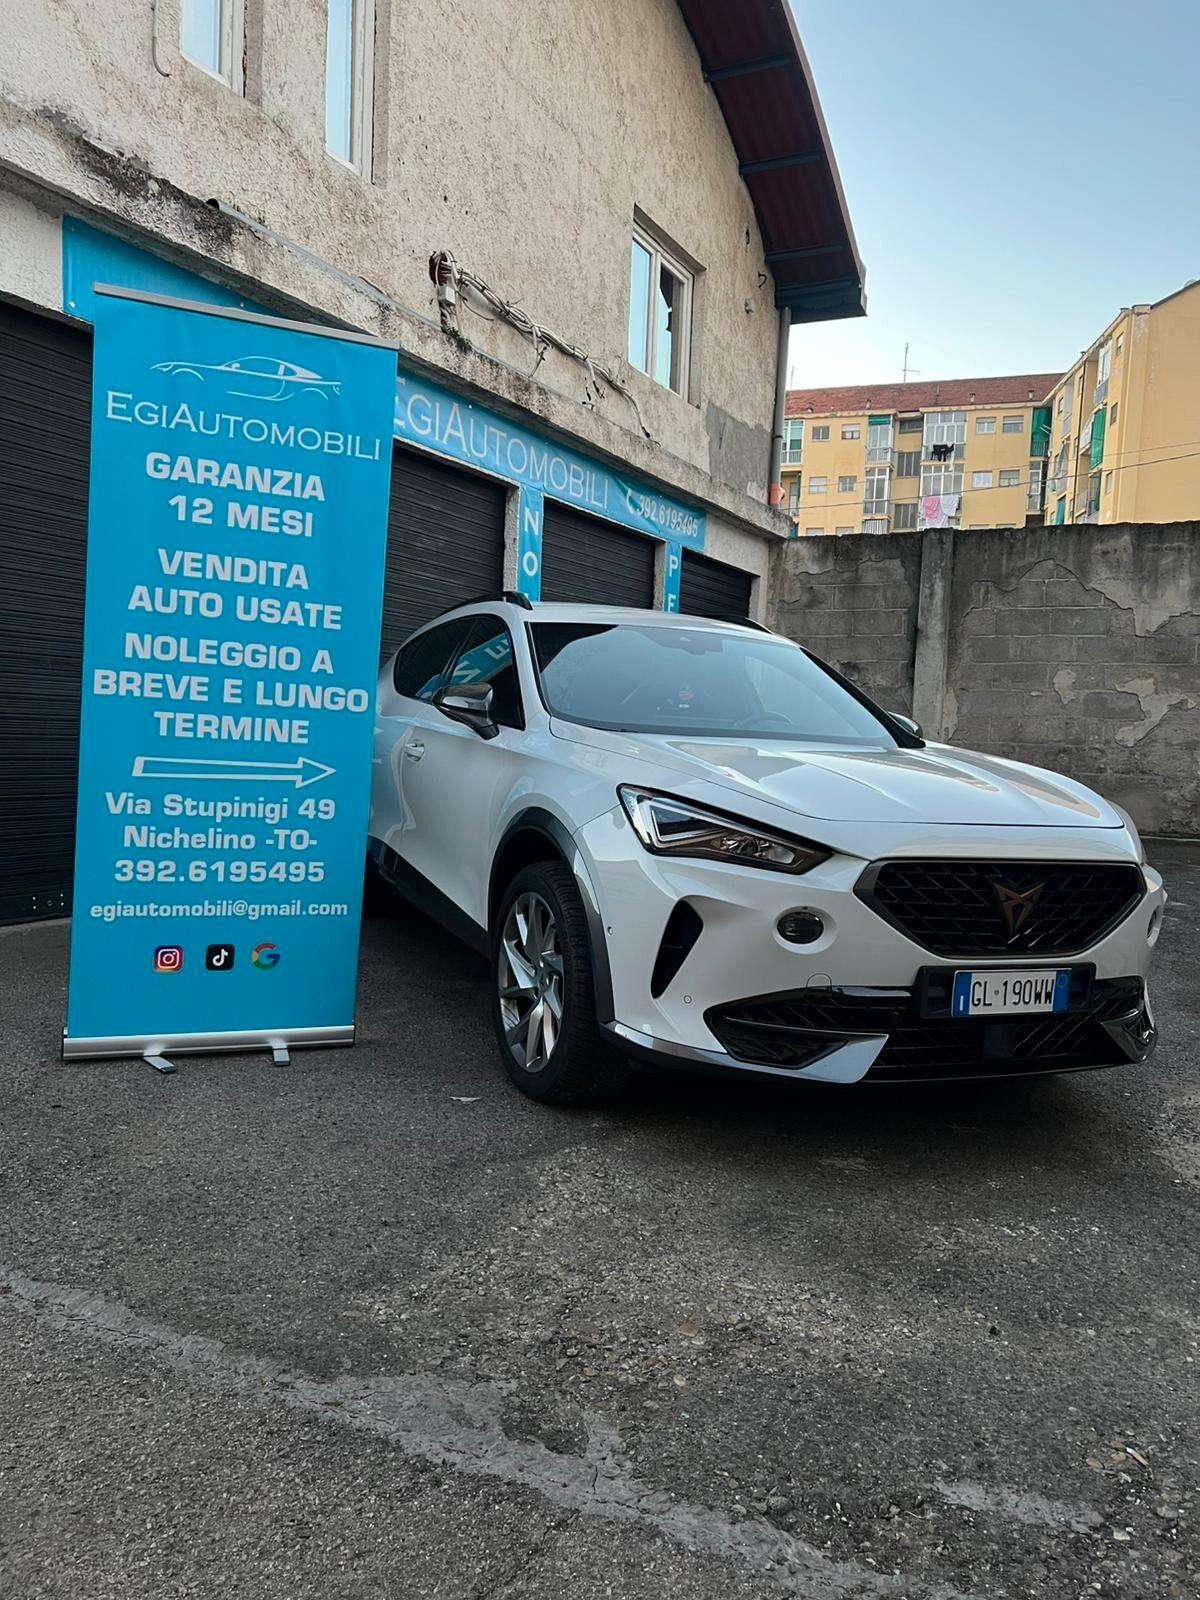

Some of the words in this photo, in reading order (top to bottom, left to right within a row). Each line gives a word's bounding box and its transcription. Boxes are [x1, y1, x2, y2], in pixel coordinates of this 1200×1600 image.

[106, 390, 381, 461] EGIAUTOMOBILI
[145, 452, 326, 501] GARANZIA
[168, 495, 214, 526] 12
[226, 502, 314, 538] MESI
[157, 548, 310, 590] VENDITA
[127, 585, 224, 619] AUTO
[235, 595, 342, 631] USATE
[124, 632, 301, 672] NOLEGGIO
[310, 650, 334, 674] A
[93, 668, 210, 702] BREVE
[223, 678, 243, 704] E
[256, 681, 370, 713] LUNGO
[153, 711, 310, 745] TERMINE
[105, 791, 152, 815] Via
[163, 793, 289, 825] Stupinigi
[298, 798, 336, 820] 49
[123, 825, 256, 850] Nichelino
[265, 829, 318, 851] -TO-
[114, 859, 325, 884] 392.6195495
[90, 899, 349, 923] egiautomobili@gmail.com
